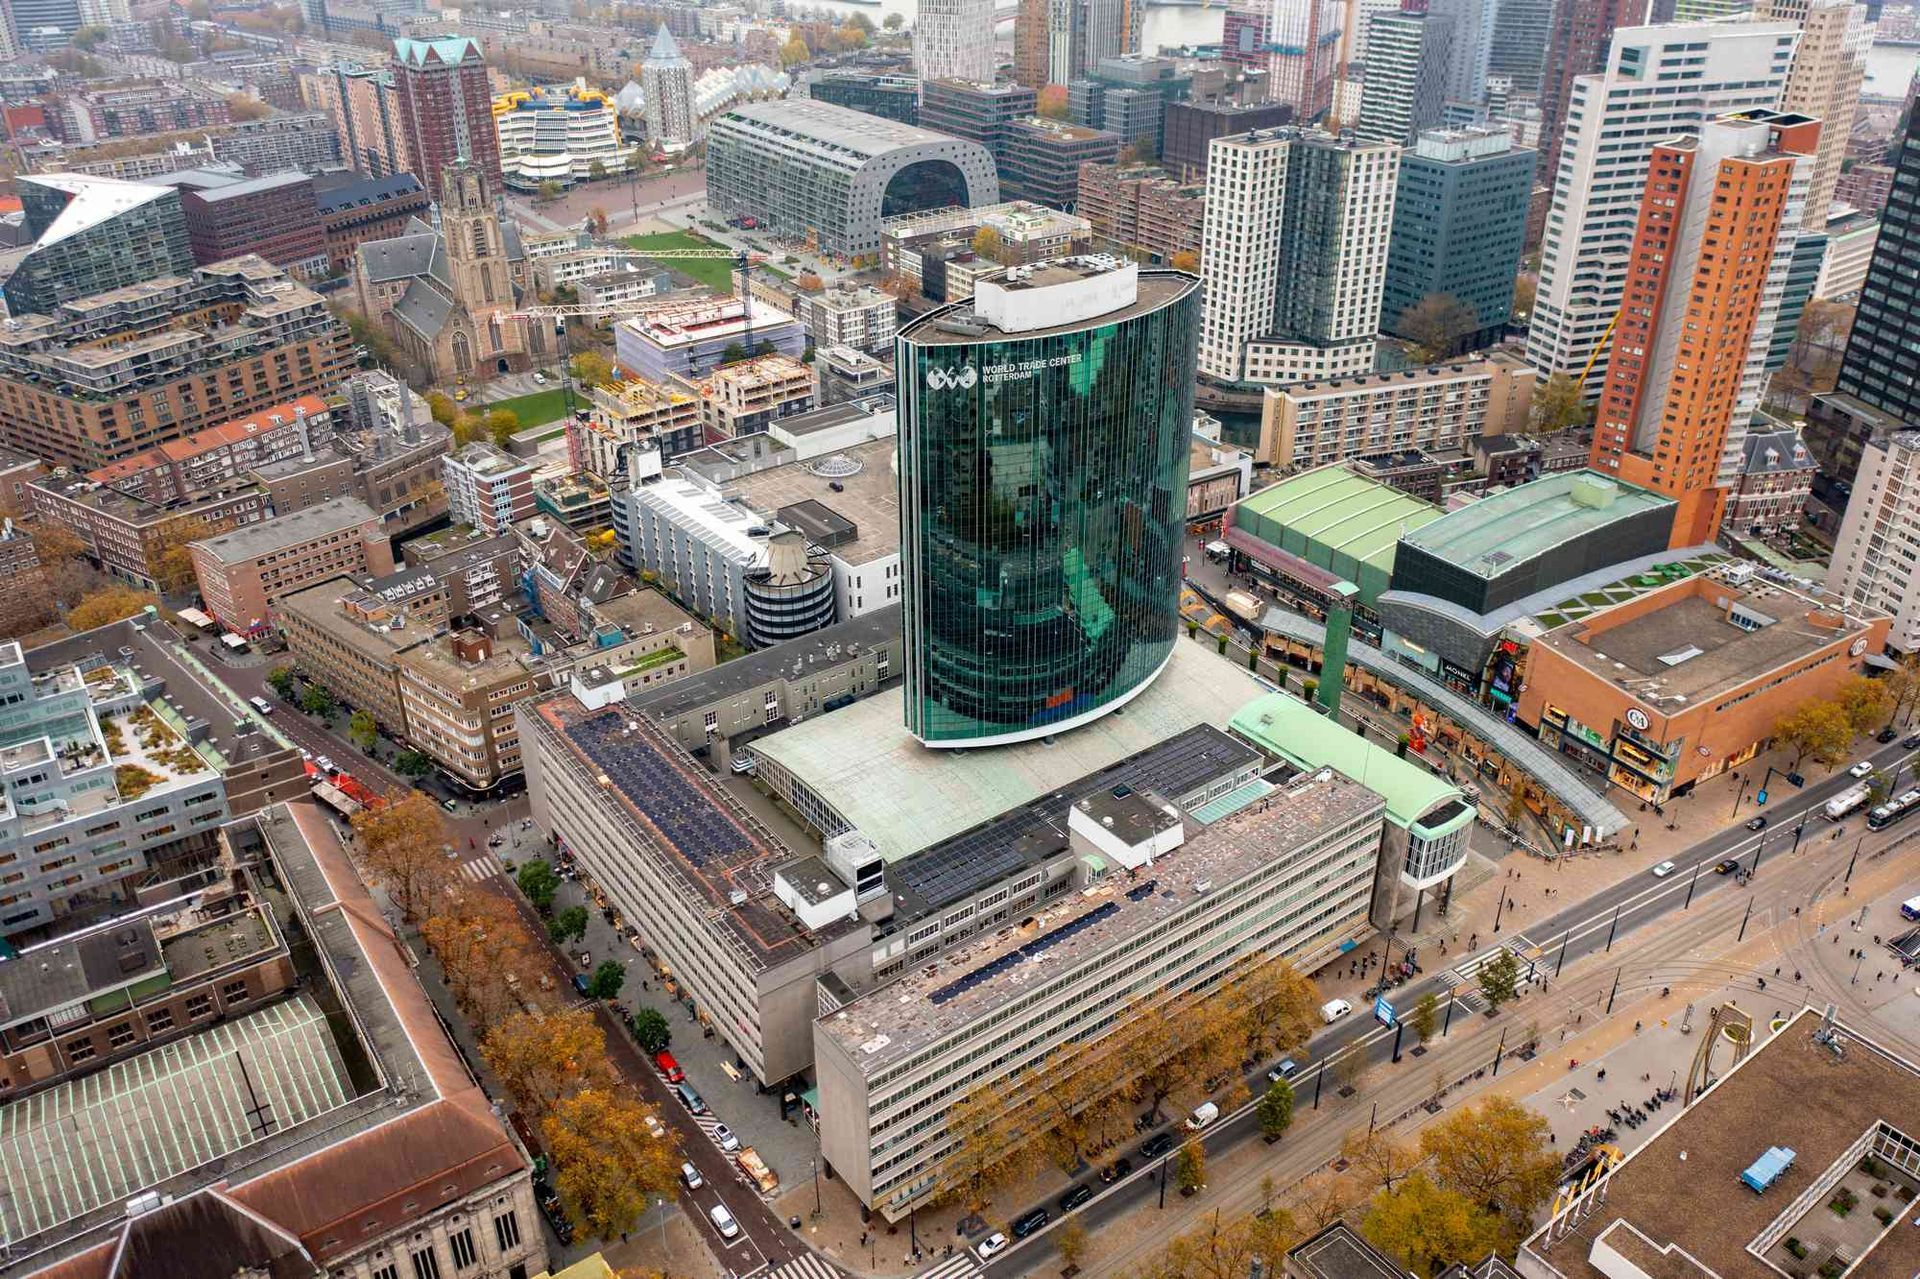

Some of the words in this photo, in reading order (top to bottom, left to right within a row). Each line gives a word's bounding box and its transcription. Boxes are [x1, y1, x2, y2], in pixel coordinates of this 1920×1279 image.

[982, 363, 1016, 374] WORLD
[1018, 359, 1047, 371] TRADE
[1049, 354, 1082, 367] CENTER
[982, 371, 1032, 383] ROTTERDAM
